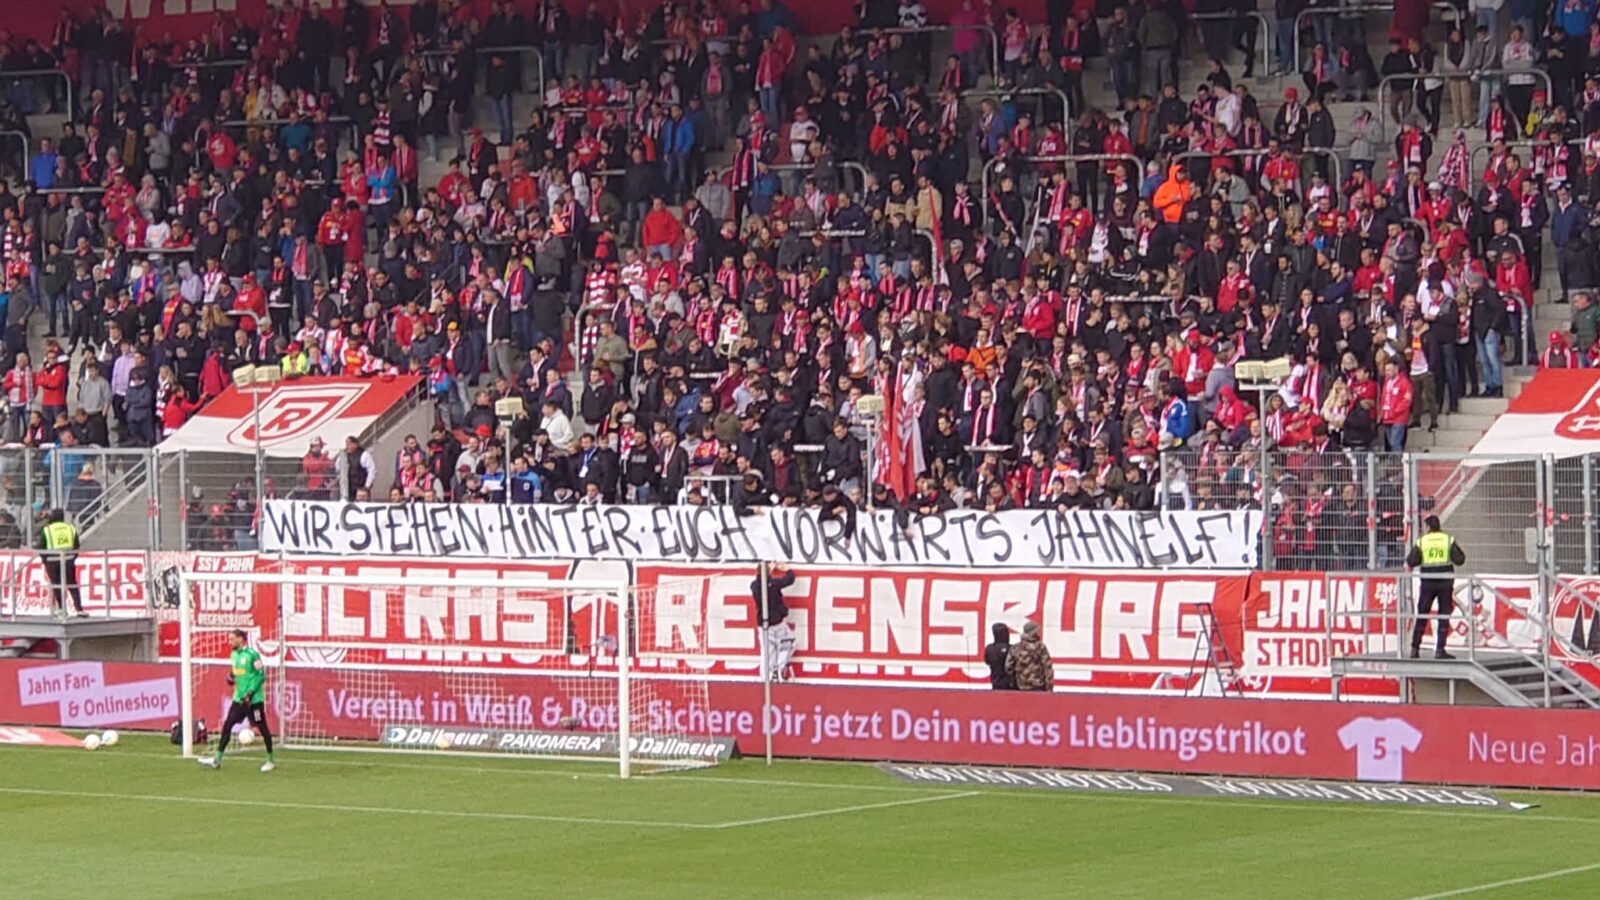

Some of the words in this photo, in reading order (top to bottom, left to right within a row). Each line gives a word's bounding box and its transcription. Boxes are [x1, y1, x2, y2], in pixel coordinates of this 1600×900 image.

[341, 501, 490, 554] STEHEN
[652, 504, 758, 558] EUCH
[197, 556, 221, 572] SSV
[221, 556, 255, 572] JAHN
[197, 579, 253, 611] 1889
[281, 566, 549, 644] ULTRAS
[1257, 579, 1364, 629] JAHN
[28, 676, 61, 696] Jahn
[65, 673, 96, 692] Fan-
[68, 701, 79, 718] &
[84, 691, 170, 717] Onlineshop
[328, 688, 425, 720] Vereint
[432, 691, 458, 722] in
[464, 694, 533, 727] Weiß
[541, 695, 562, 728] &
[571, 696, 618, 729] Rot
[647, 699, 753, 735] Sichere
[762, 704, 806, 737] Dir
[811, 705, 882, 744] jetzt
[892, 708, 961, 742] Dein
[970, 717, 1060, 747] neues
[1069, 714, 1306, 761] Lieblingstrikot
[638, 737, 725, 757] Dallmeier
[1373, 737, 1386, 761] 5
[1468, 731, 1546, 764] Neue
